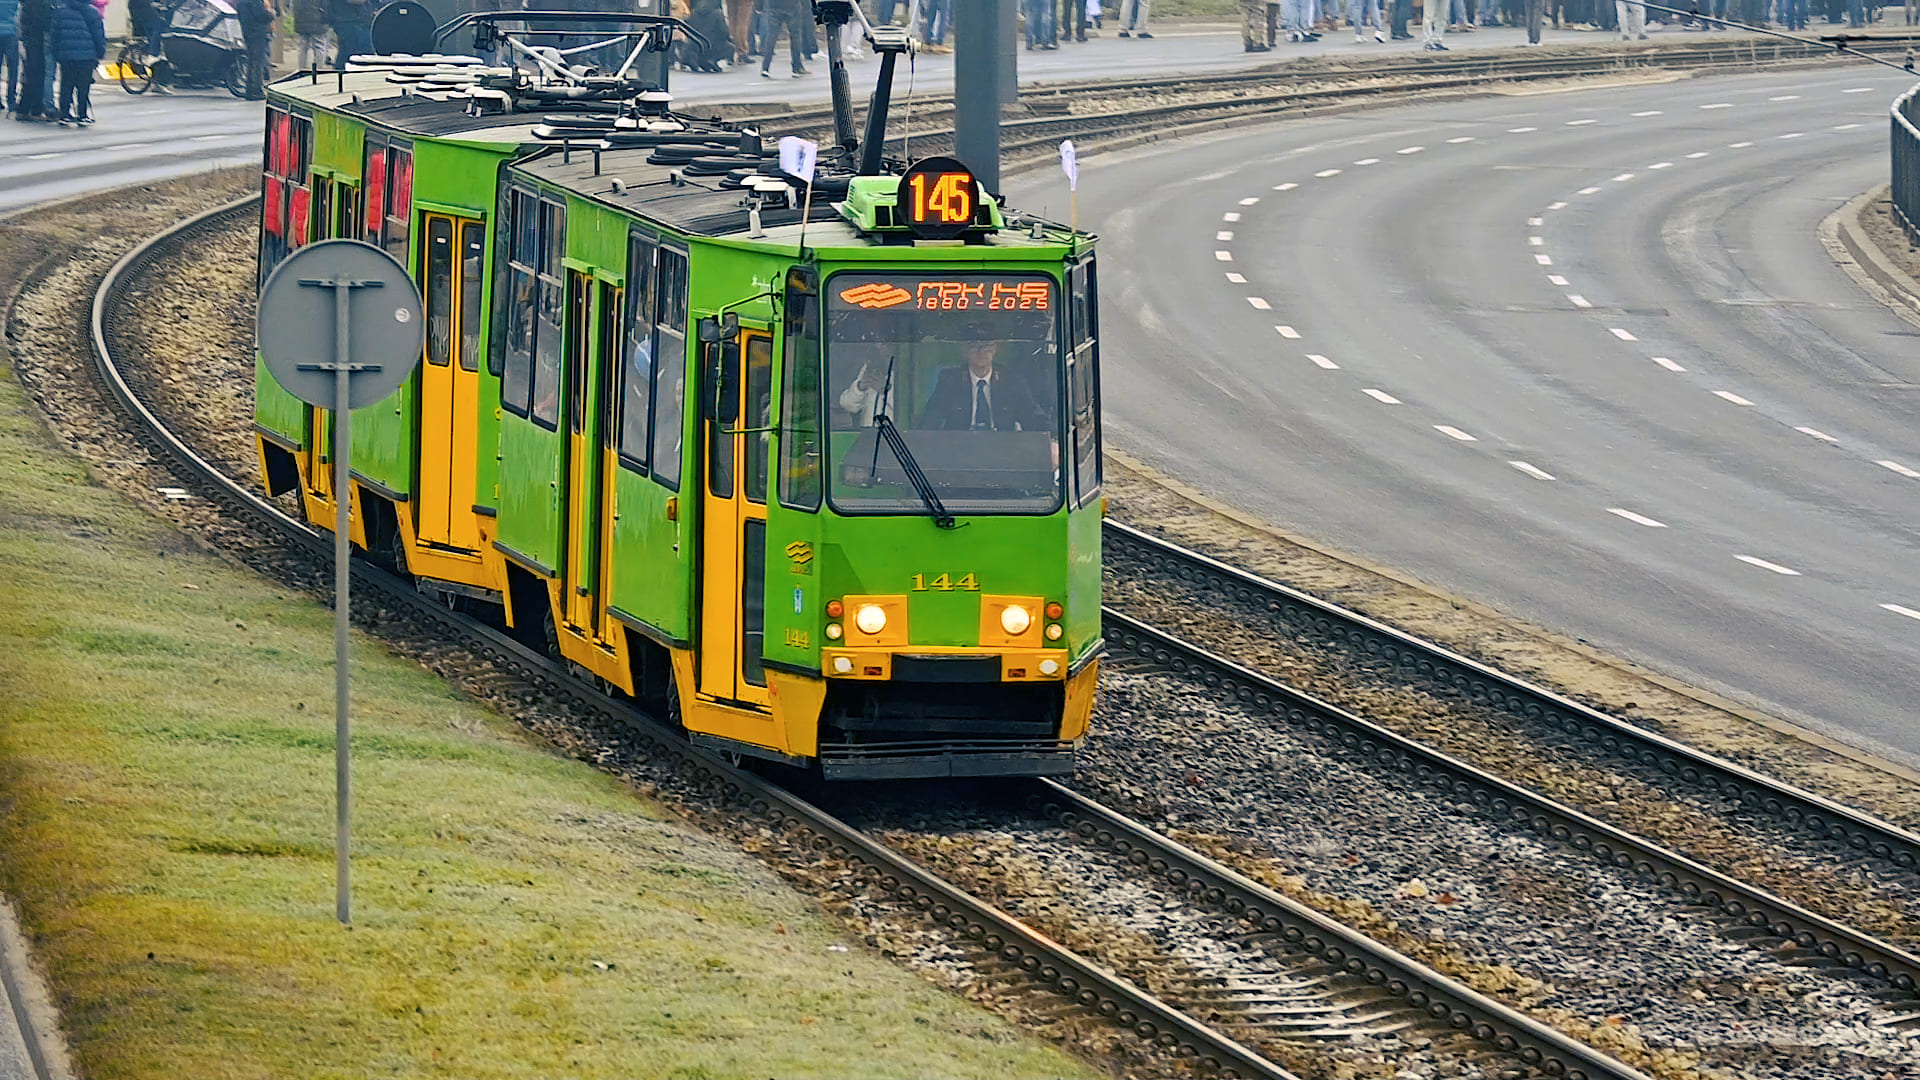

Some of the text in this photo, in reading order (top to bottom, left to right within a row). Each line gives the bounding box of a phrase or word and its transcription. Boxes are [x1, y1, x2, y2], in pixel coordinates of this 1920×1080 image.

[909, 173, 970, 222] 145
[991, 281, 1049, 298] 145
[911, 572, 981, 592] 144
[784, 627, 810, 649] 144
